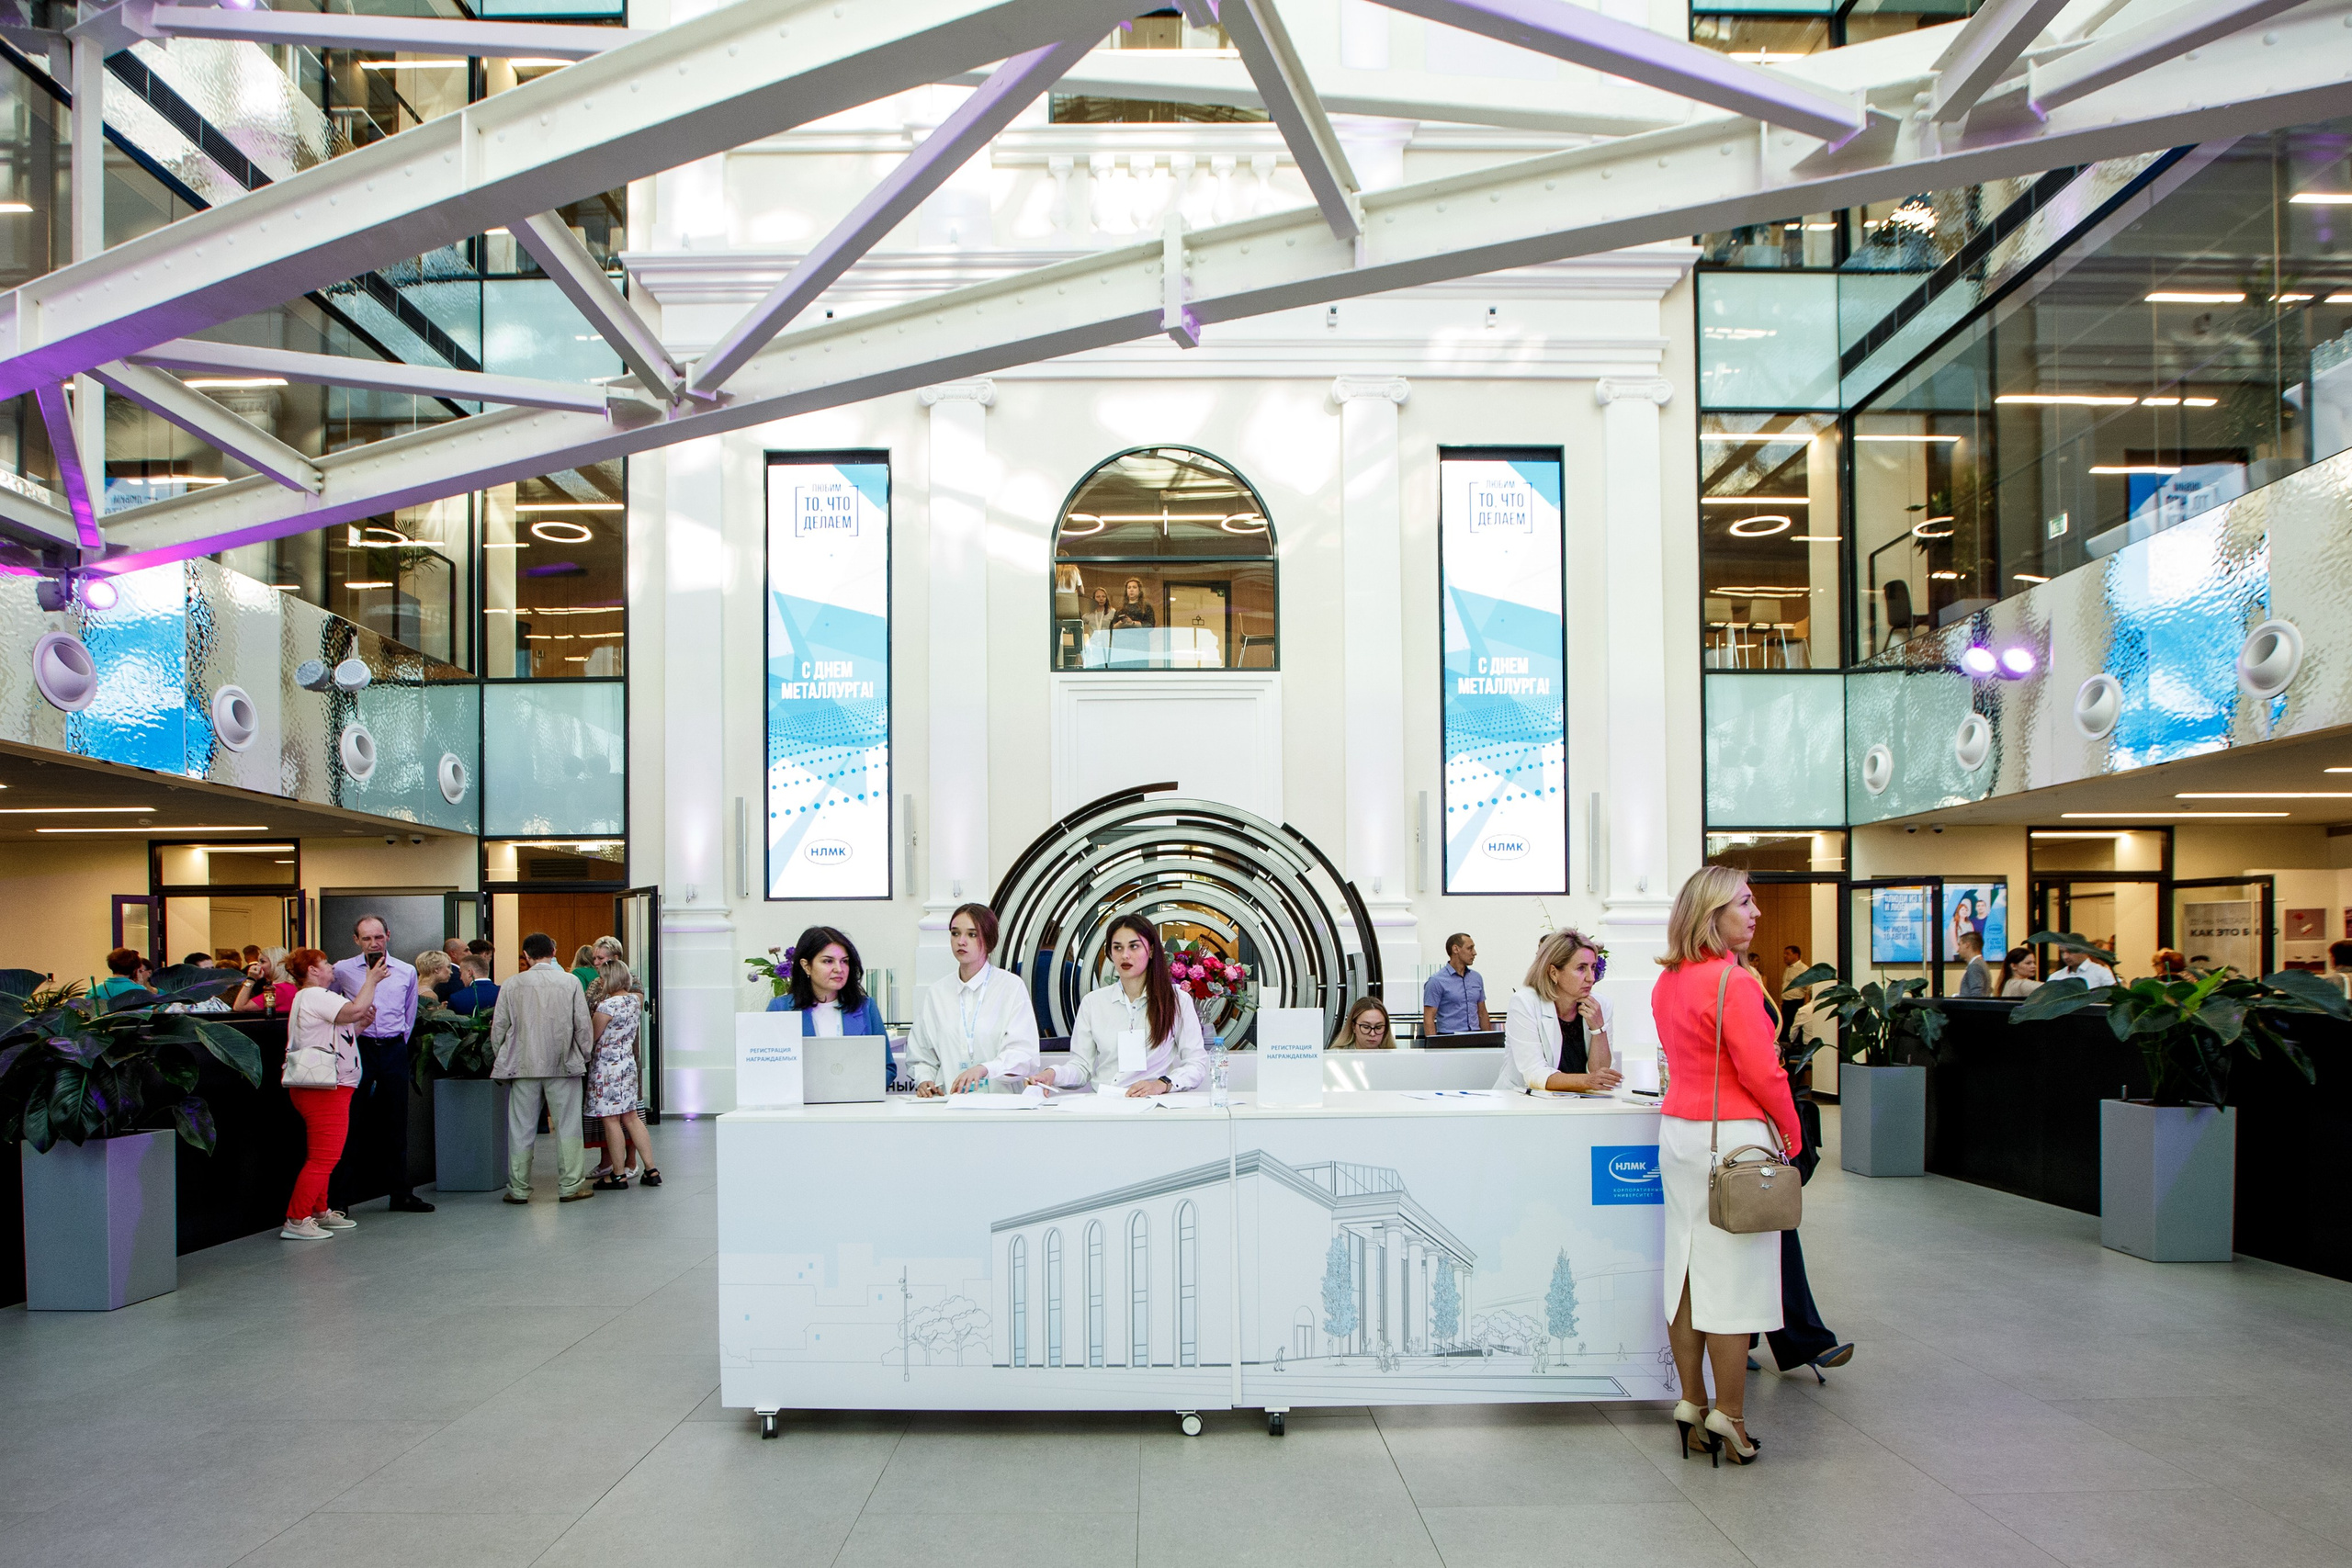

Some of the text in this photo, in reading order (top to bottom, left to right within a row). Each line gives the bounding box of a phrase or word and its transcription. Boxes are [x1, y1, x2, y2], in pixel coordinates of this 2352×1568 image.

[812, 483, 842, 492] ЛЮБИМ
[1486, 479, 1515, 489] ЛЮБИМ
[804, 496, 851, 512] ТО, ЧТО
[1479, 492, 1524, 508] ТО, ЧТО
[804, 515, 852, 531] ДЕЛАЕМ
[1478, 512, 1526, 526] ДЕЛАЕМ
[801, 660, 854, 681] С ДНЕМ
[1478, 657, 1529, 676] С ДНЕМ
[781, 681, 874, 700] МЕТАЛЛУРГА!
[1457, 677, 1551, 695] МЕТАЛЛУРГА!
[810, 847, 846, 856] НЛМК
[1488, 842, 1523, 852] НЛМК
[2190, 929, 2214, 937] КАК
[2216, 928, 2240, 937] ЭТО
[1615, 1162, 1646, 1170] НЛМК
